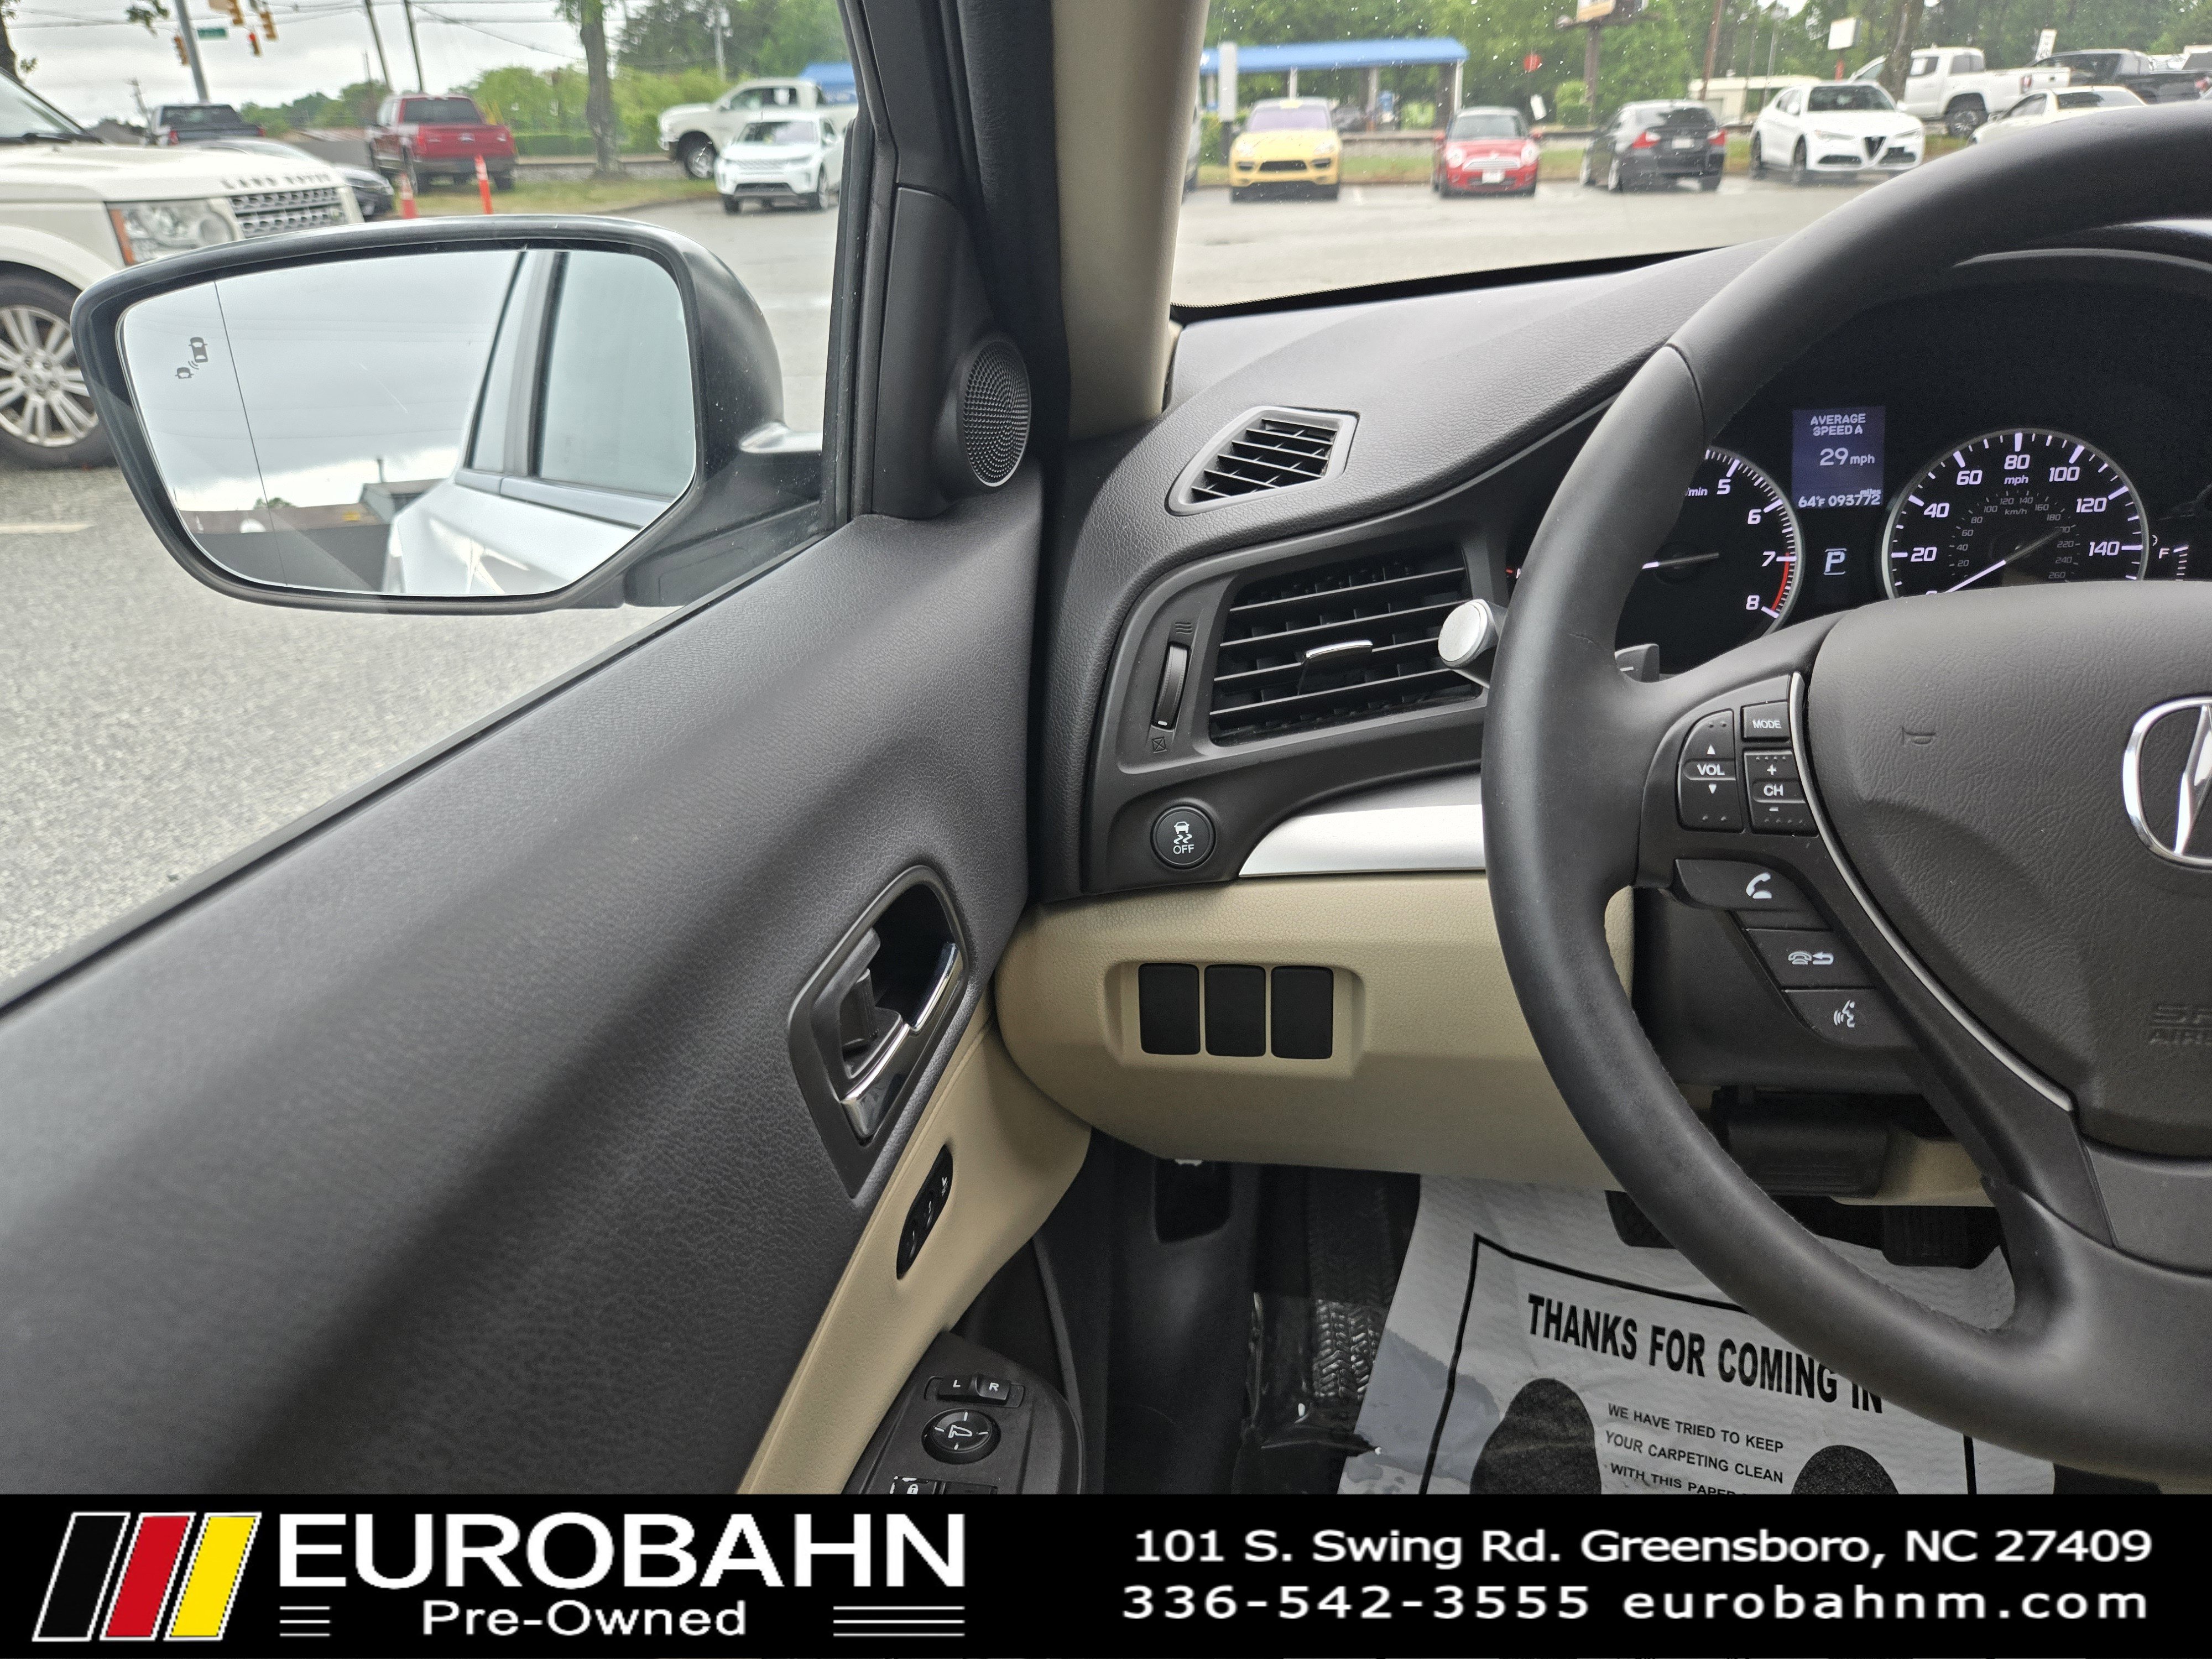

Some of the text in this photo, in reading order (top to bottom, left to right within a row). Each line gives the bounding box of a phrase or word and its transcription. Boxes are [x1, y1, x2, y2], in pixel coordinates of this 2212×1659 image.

[1810, 413, 1866, 425] AVERAGE
[1813, 424, 1863, 436] SPEED A
[1819, 447, 1875, 466] 29 mph
[2004, 454, 2031, 470] 80
[1956, 469, 1983, 486] 60
[2004, 474, 2030, 486] mph
[2049, 466, 2080, 482] 100
[1716, 478, 1732, 495] 5
[1828, 494, 1881, 507] 093772
[2075, 497, 2107, 513] 120
[1747, 509, 1761, 525] 6
[1923, 503, 1950, 518] 40
[1910, 546, 1938, 562] 20
[2089, 541, 2120, 557] 140
[2158, 547, 2170, 559] F
[1761, 551, 1776, 567] 7
[1824, 551, 1846, 572] P
[2055, 556, 2073, 564] 240
[2048, 571, 2066, 580] 260
[1745, 594, 1760, 611] 8
[1752, 719, 1782, 729] MODE
[1697, 763, 1725, 776] VOL
[1763, 784, 1784, 797] CH
[1173, 844, 1194, 855] OFF
[1527, 1292, 1637, 1360] THANKS
[1648, 1324, 1705, 1378] FOR
[1718, 1338, 1838, 1403] COMING
[953, 1379, 961, 1387] L
[989, 1382, 999, 1391] R
[1608, 1402, 1784, 1453] WE HAVE TRIED TO KEEP
[1605, 1430, 1783, 1484] YOUR CARPETING CLEAN
[1610, 1462, 1646, 1480] WITH
[1650, 1473, 1683, 1489] THIS
